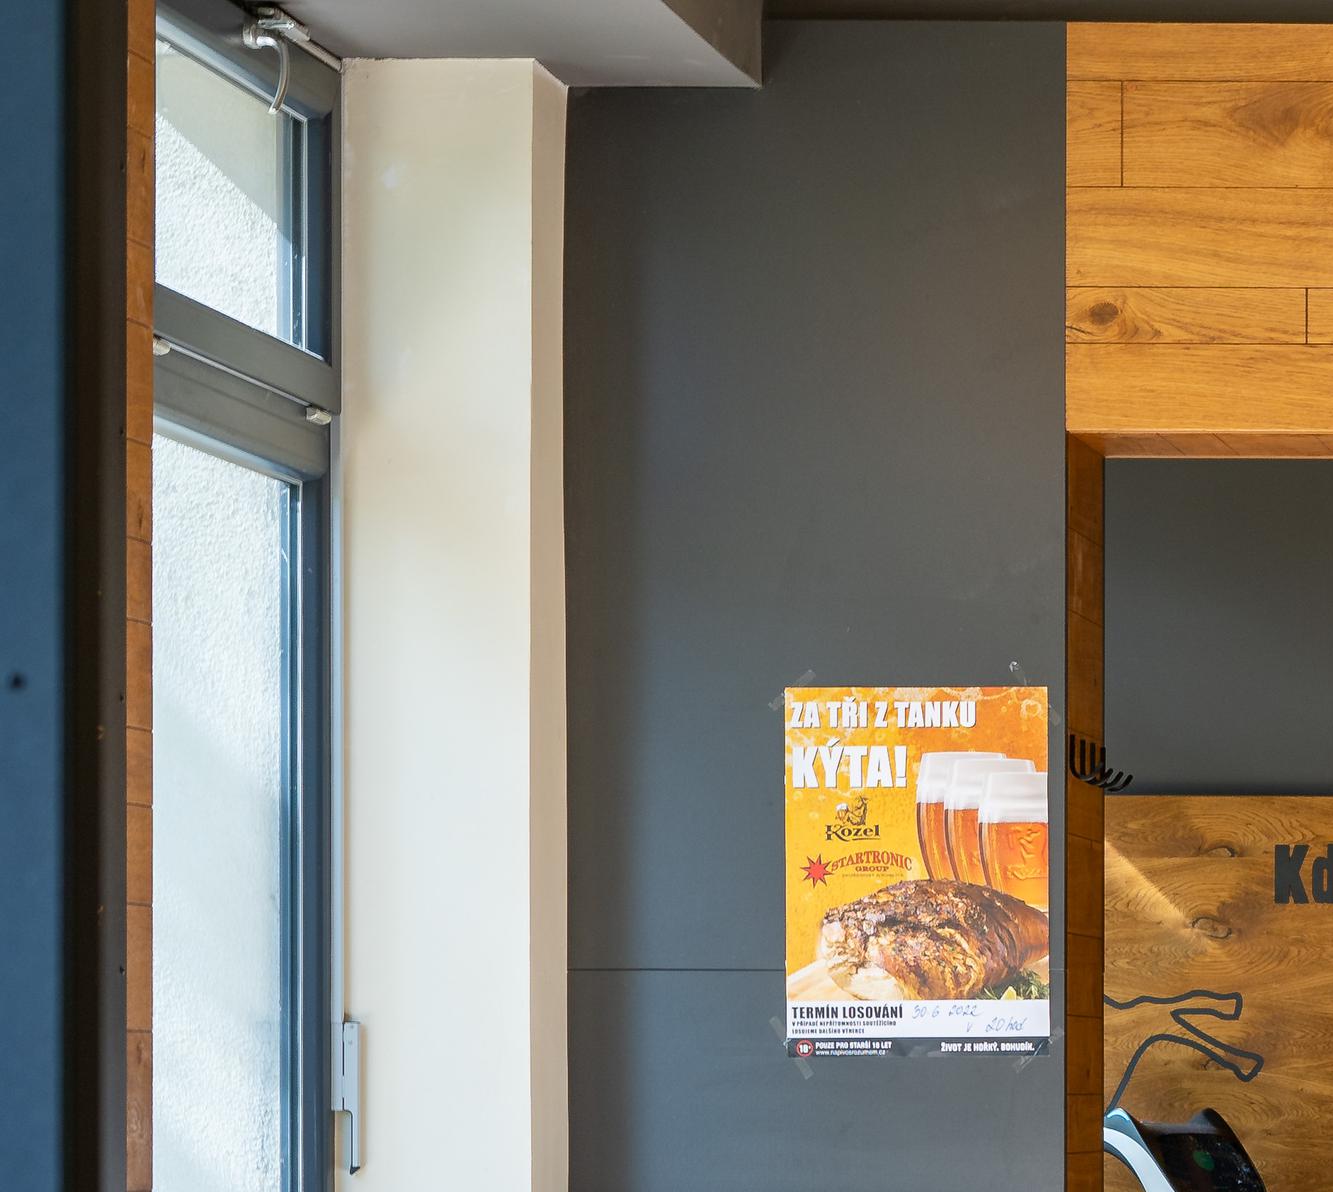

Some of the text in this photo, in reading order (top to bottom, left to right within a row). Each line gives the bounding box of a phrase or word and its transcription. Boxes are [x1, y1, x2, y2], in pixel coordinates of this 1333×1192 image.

[790, 695, 977, 729] ZA TŘI Z TANKU
[791, 737, 908, 789] KÝTA!
[825, 824, 881, 842] Kozel
[831, 850, 913, 872] STARTRONIC
[791, 1002, 904, 1019] TERMÍN LOSOVÁNÍ
[948, 1004, 983, 1018] 2022
[815, 1041, 835, 1050] POUZE
[836, 1041, 849, 1050] PRO
[850, 1040, 871, 1050] STARŠÍ
[881, 1041, 892, 1050] LET
[941, 1041, 1035, 1053] ŽIVOT JE HOŘKÝ. BOHUDÍK.
